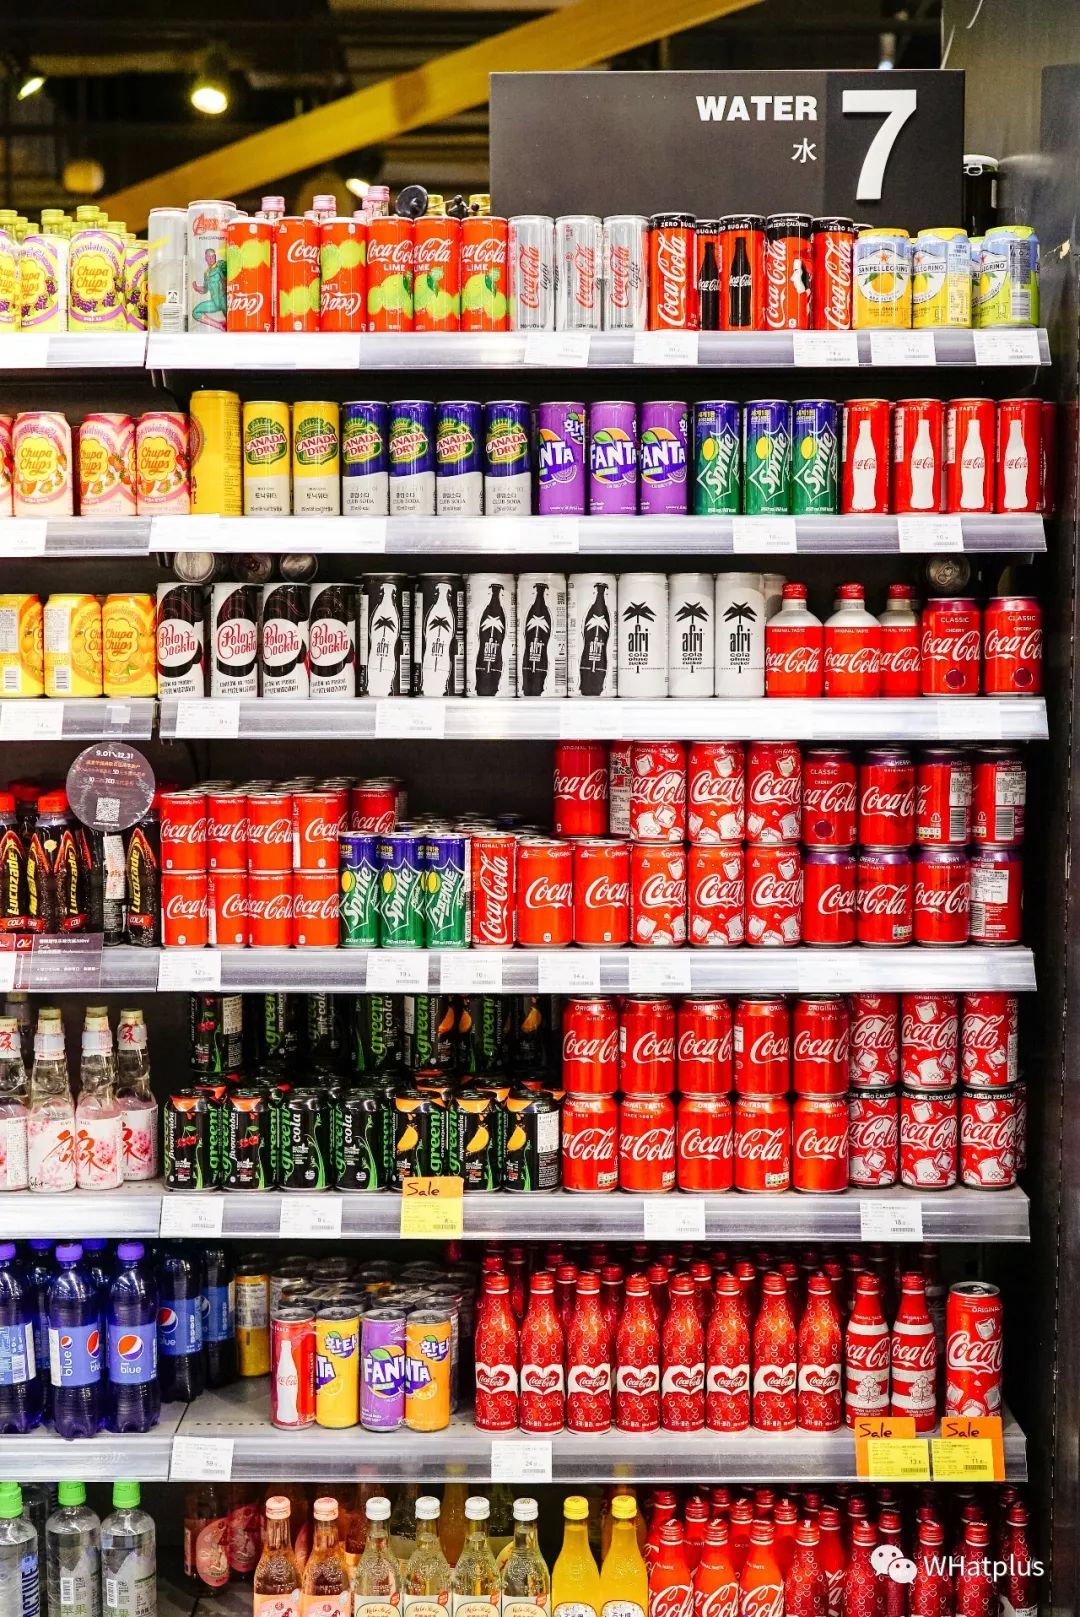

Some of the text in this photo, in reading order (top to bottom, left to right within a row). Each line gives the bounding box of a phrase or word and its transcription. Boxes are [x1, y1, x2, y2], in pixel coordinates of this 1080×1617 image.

[696, 95, 818, 121] WATER
[792, 137, 819, 164] 水
[843, 89, 918, 200] 7
[661, 220, 679, 228] ZERO
[728, 222, 750, 232] SUGAR
[78, 265, 110, 278] Chupa
[384, 264, 407, 272] LIME
[466, 264, 488, 272] LIME
[519, 244, 540, 309] Coca-Cola
[575, 243, 595, 309] Coca-Cola
[611, 243, 630, 309] Coca-Cola
[77, 276, 109, 294] Chups
[657, 230, 687, 327] Coca-Cola
[825, 232, 851, 329] Coca-Cola
[246, 434, 286, 451] CANADA
[255, 445, 276, 457] DRY
[297, 434, 337, 451] CANADA
[306, 445, 328, 457] DRY
[349, 444, 370, 457] DRY
[396, 444, 416, 456] DRY
[442, 444, 462, 456] DRY
[486, 434, 527, 452] CANADA
[496, 445, 518, 457] DRY
[21, 447, 53, 460] Chupa
[141, 447, 171, 460] Chupa
[19, 459, 52, 476] Chups
[140, 459, 170, 476] Chups
[705, 434, 734, 496] Sprite
[758, 432, 787, 495] Sprite
[803, 432, 833, 495] Sprite
[1007, 614, 1036, 622] CLASSIC
[376, 637, 389, 655] afri
[432, 637, 444, 655] afri
[628, 623, 649, 652] afri
[683, 623, 703, 652] afri
[730, 623, 750, 652] afri
[6, 849, 20, 916] Lucozade
[67, 852, 79, 915] Lucozade
[130, 848, 141, 913] Lucozade
[344, 866, 371, 927] Sprite
[385, 866, 413, 927] Sprite
[479, 849, 508, 944] Coca-Cola
[7, 918, 25, 928] COLA
[644, 1101, 665, 1109] TASTE
[292, 1113, 302, 1143] cola
[343, 1113, 353, 1144] cola
[281, 1105, 292, 1171] green
[430, 1108, 442, 1171] green
[449, 1107, 459, 1171] green
[407, 1181, 440, 1197] Sale
[63, 1350, 73, 1377] blue
[121, 1364, 142, 1374] blue
[859, 1421, 893, 1438] Sale
[946, 1421, 980, 1438] Sale
